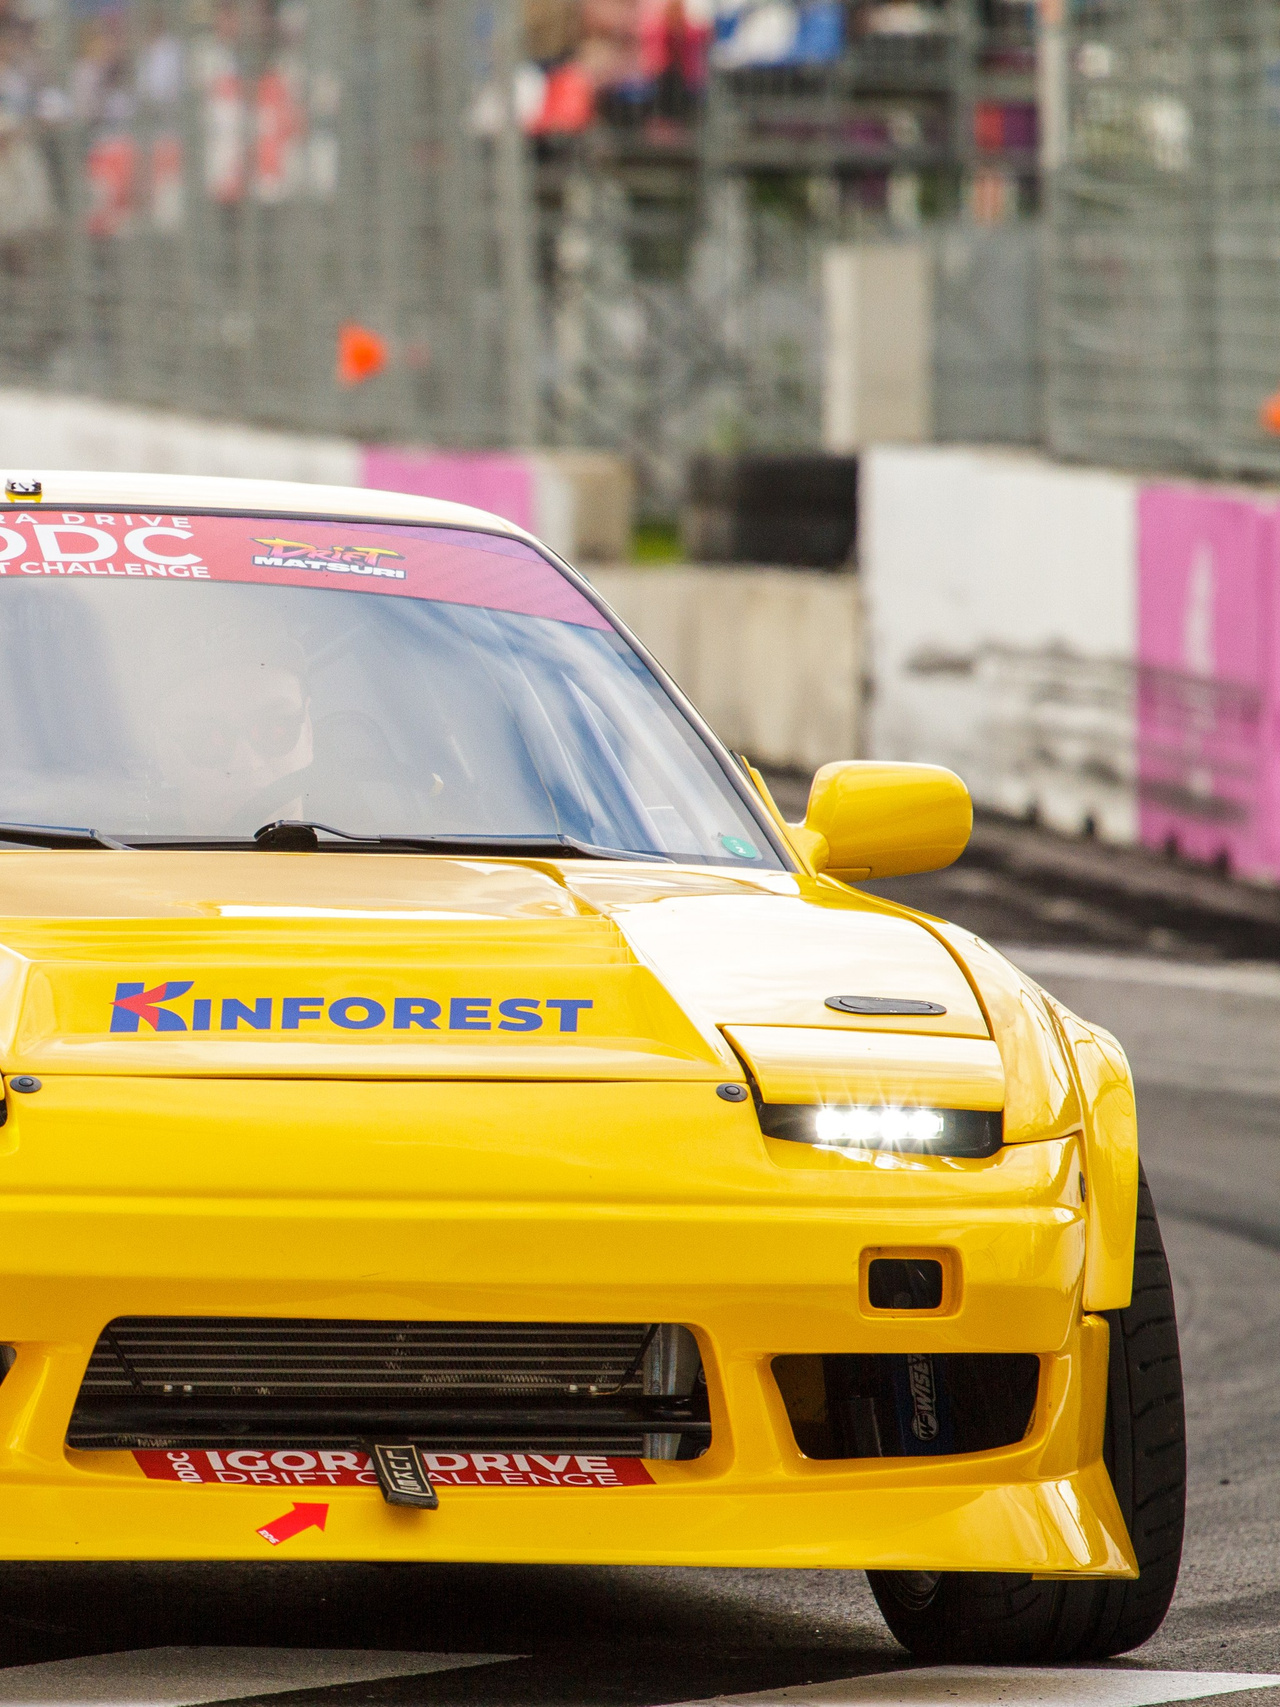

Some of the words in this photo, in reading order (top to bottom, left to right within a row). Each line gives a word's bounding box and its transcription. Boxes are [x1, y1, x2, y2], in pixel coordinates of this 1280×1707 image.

[62, 513, 192, 528] DRIVE
[19, 562, 211, 578] CHALLENGE
[253, 555, 406, 579] MATSURI
[108, 980, 594, 1033] KINFOREST
[166, 1451, 204, 1483] IDDC
[422, 1453, 616, 1474] DRIVE
[215, 1471, 341, 1484] DRIFT
[355, 1472, 624, 1486] CALLENGE
